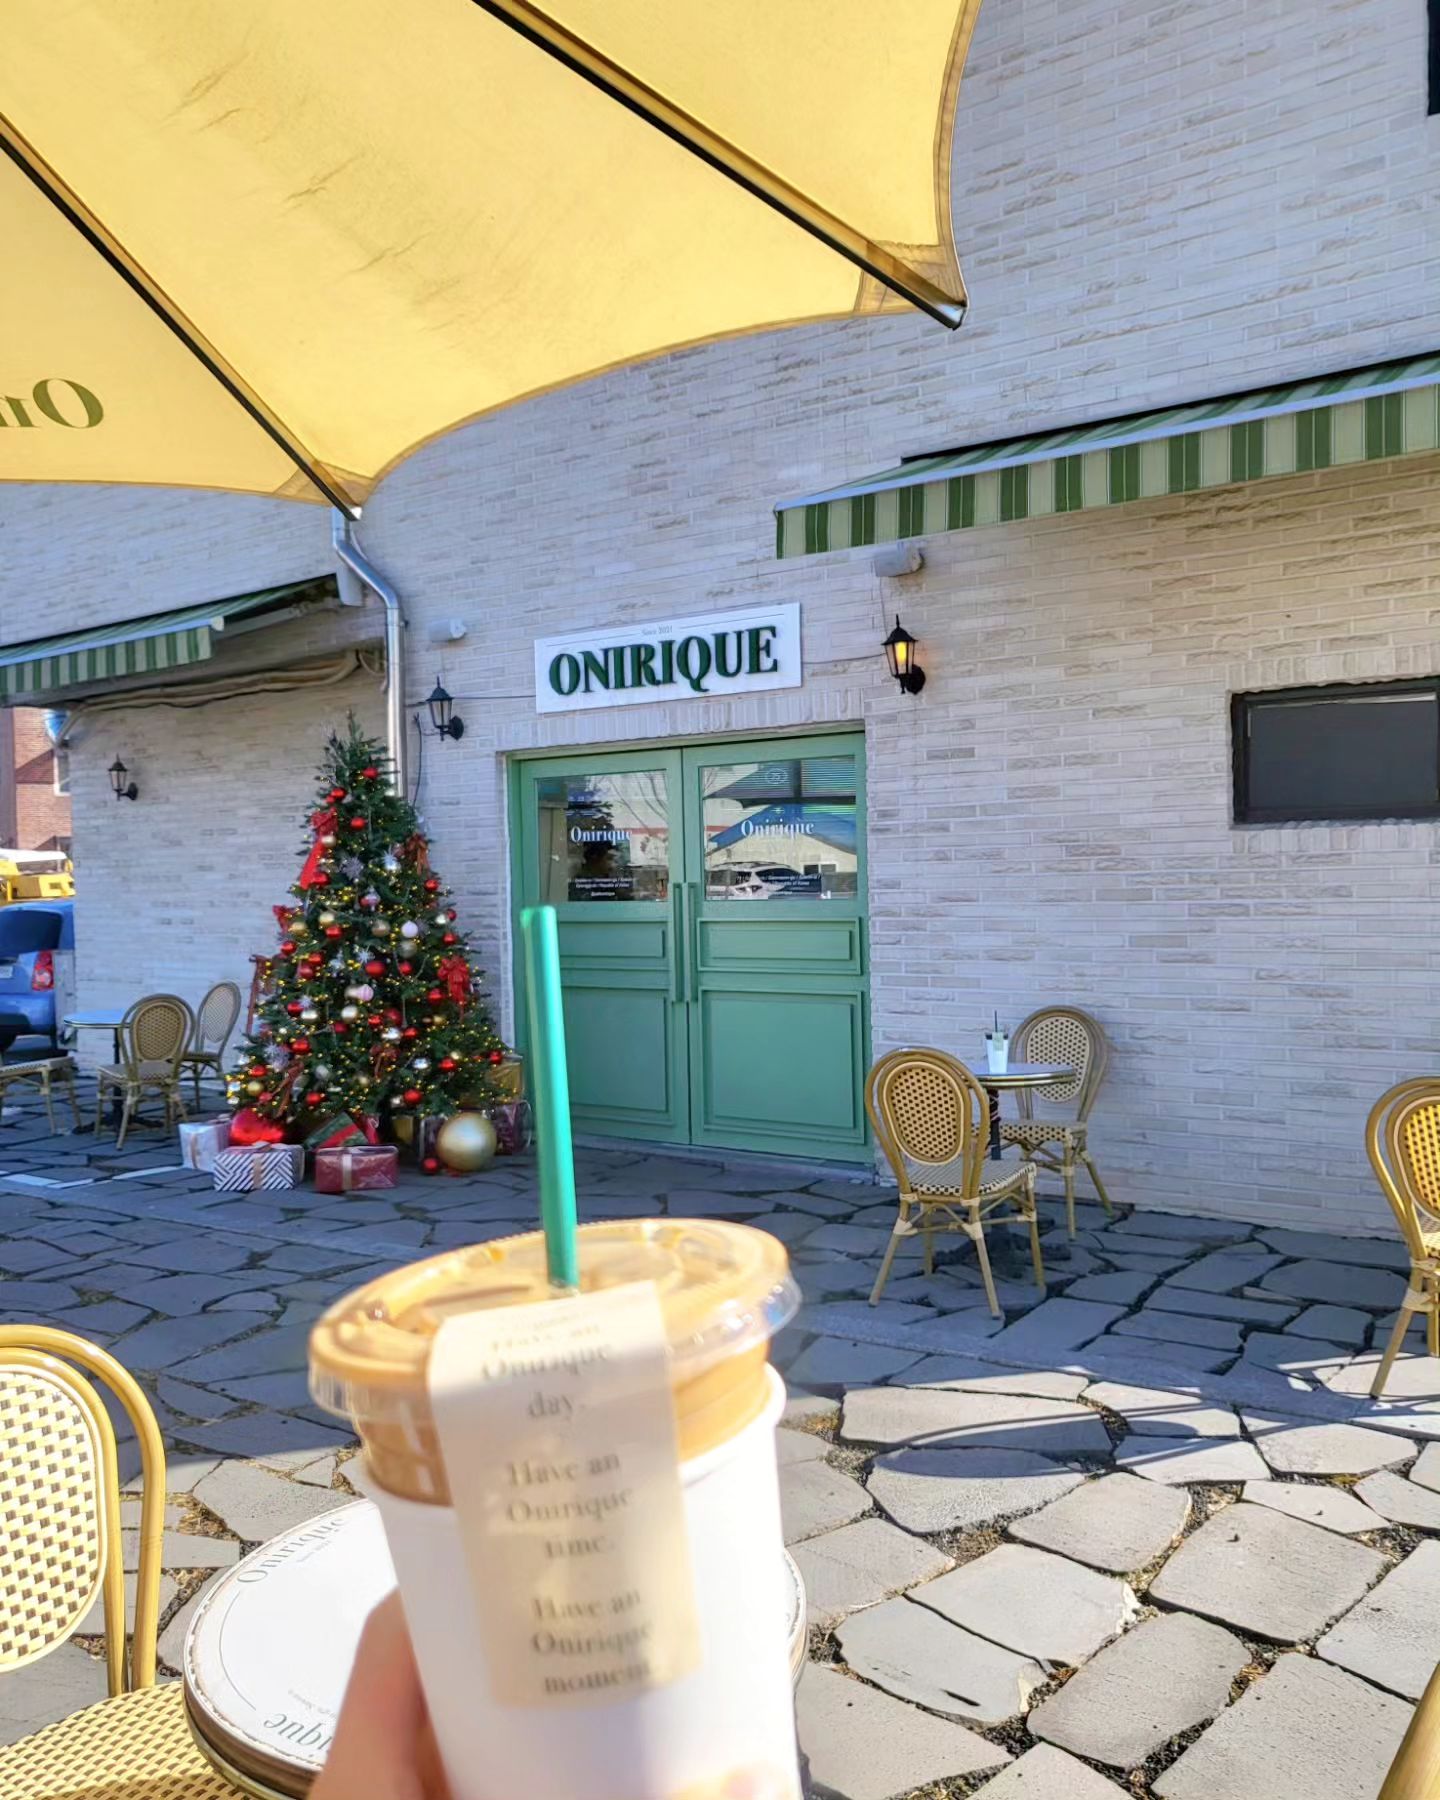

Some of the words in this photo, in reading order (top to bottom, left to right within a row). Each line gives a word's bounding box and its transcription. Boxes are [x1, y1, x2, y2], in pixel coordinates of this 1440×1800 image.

[549, 625, 778, 695] ONIRIQUE
[570, 826, 633, 846] Onirique
[741, 818, 815, 840] Onirique
[507, 1460, 579, 1488] Have
[588, 1453, 622, 1476] an
[237, 1517, 344, 1583] Onirique
